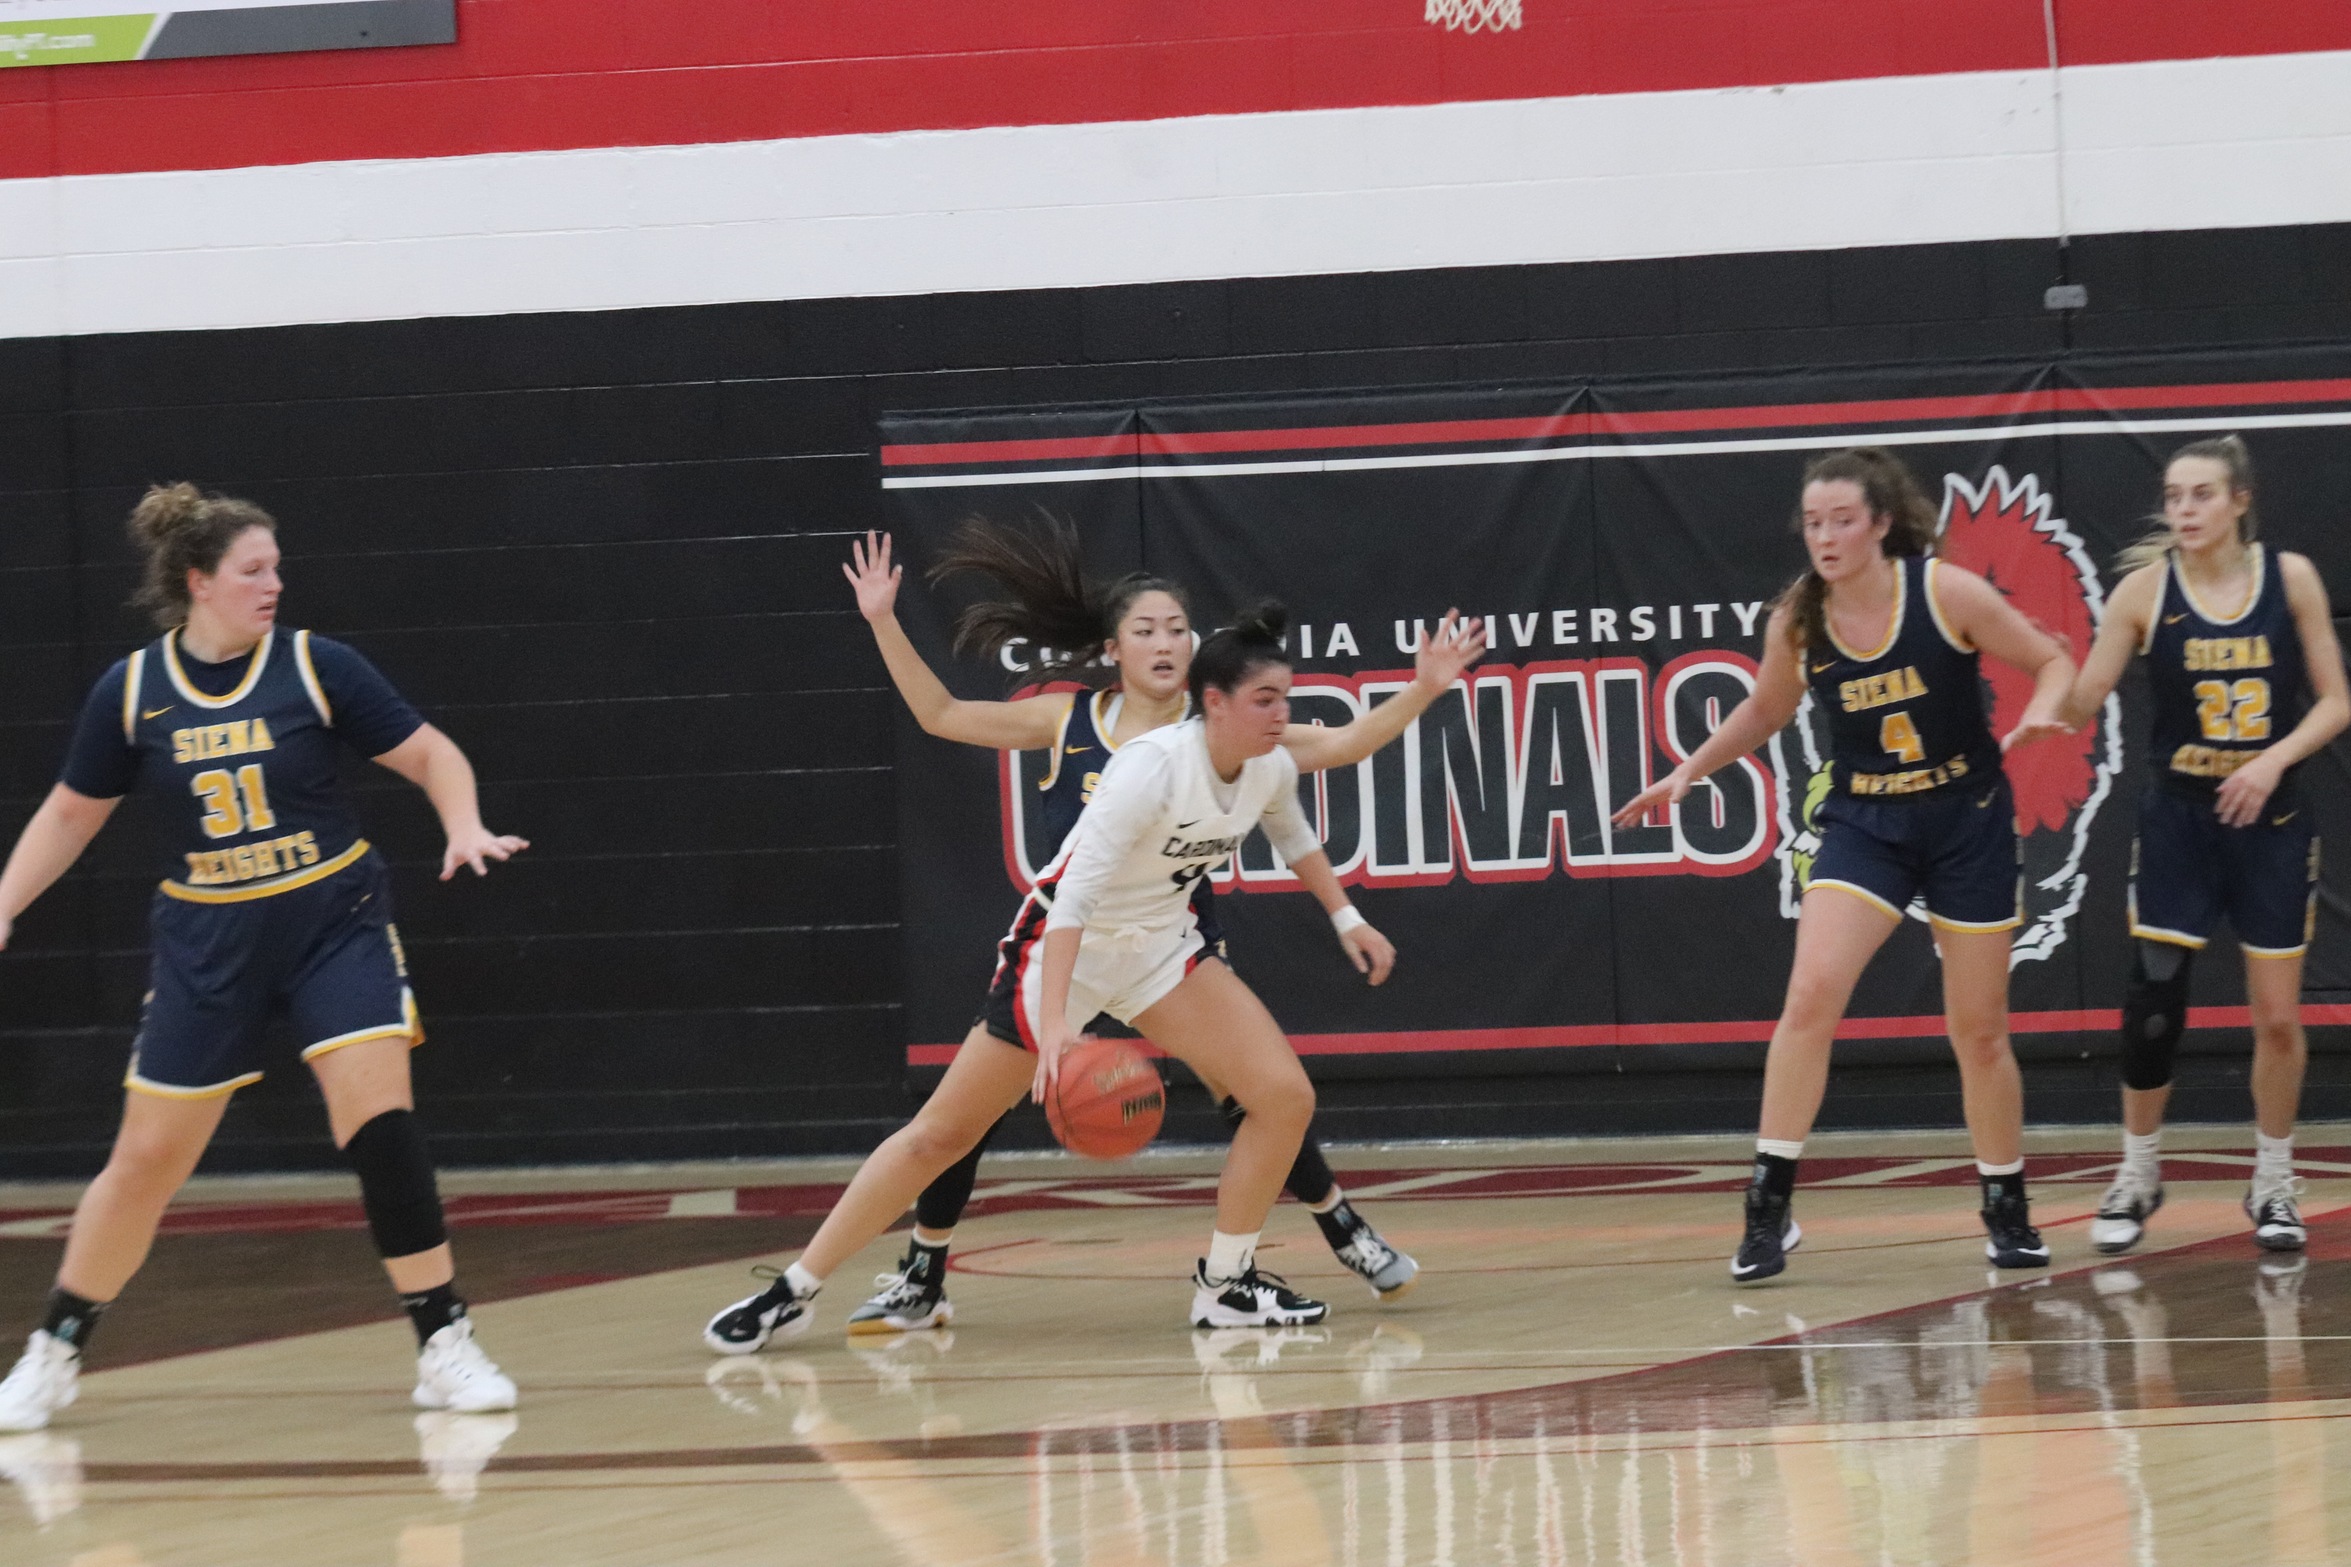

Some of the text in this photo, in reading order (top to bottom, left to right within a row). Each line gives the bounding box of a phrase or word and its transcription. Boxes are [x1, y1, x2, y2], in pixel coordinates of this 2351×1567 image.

[1394, 601, 1764, 654] UNIVERSITY
[2183, 635, 2274, 671] SIENA
[1839, 665, 1929, 713] SIENA
[2192, 677, 2272, 742] 22
[171, 717, 276, 764] SIENA
[1879, 711, 1927, 764] 4
[998, 648, 1779, 897] DINALS
[190, 763, 277, 839] 31
[184, 830, 321, 885] HEIGHTS
